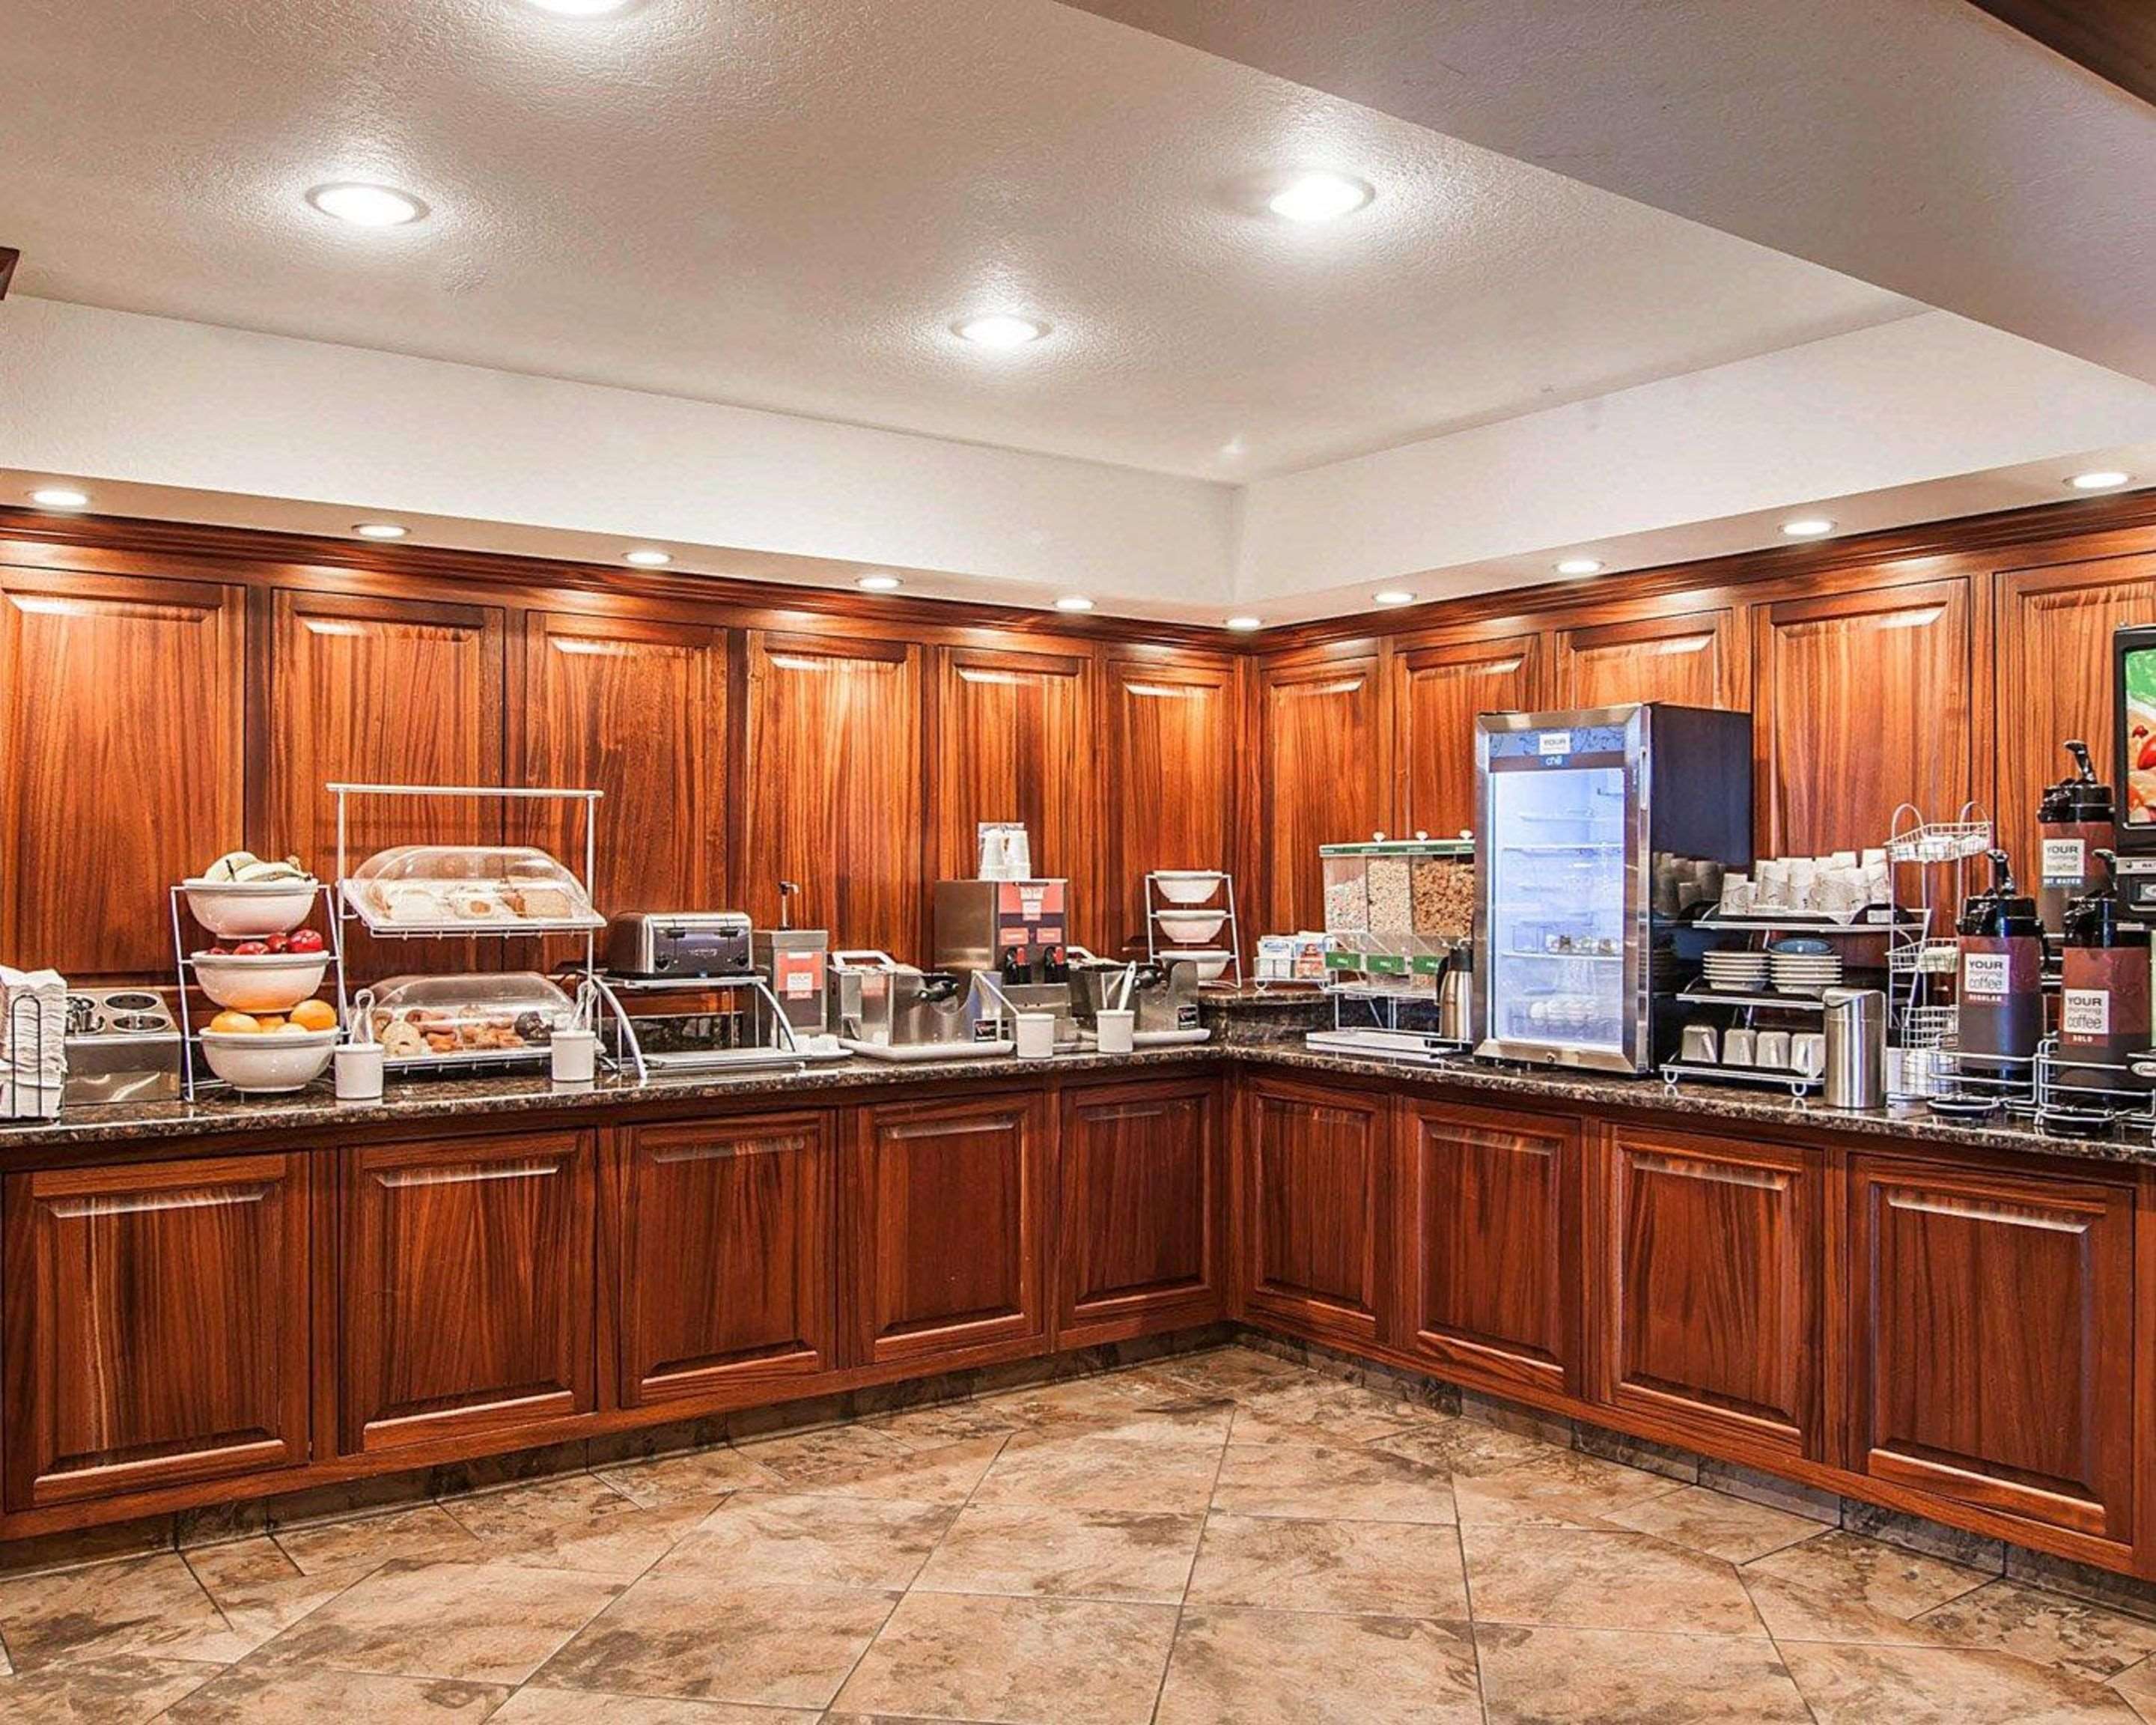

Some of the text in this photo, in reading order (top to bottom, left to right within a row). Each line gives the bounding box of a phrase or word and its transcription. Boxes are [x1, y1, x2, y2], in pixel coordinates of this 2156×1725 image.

[2047, 845, 2078, 854] YOUR
[1970, 961, 2003, 970] YOUR
[1969, 976, 2003, 990] coffee
[2068, 997, 2102, 1006] YOUR
[2068, 1014, 2102, 1029] coffee
